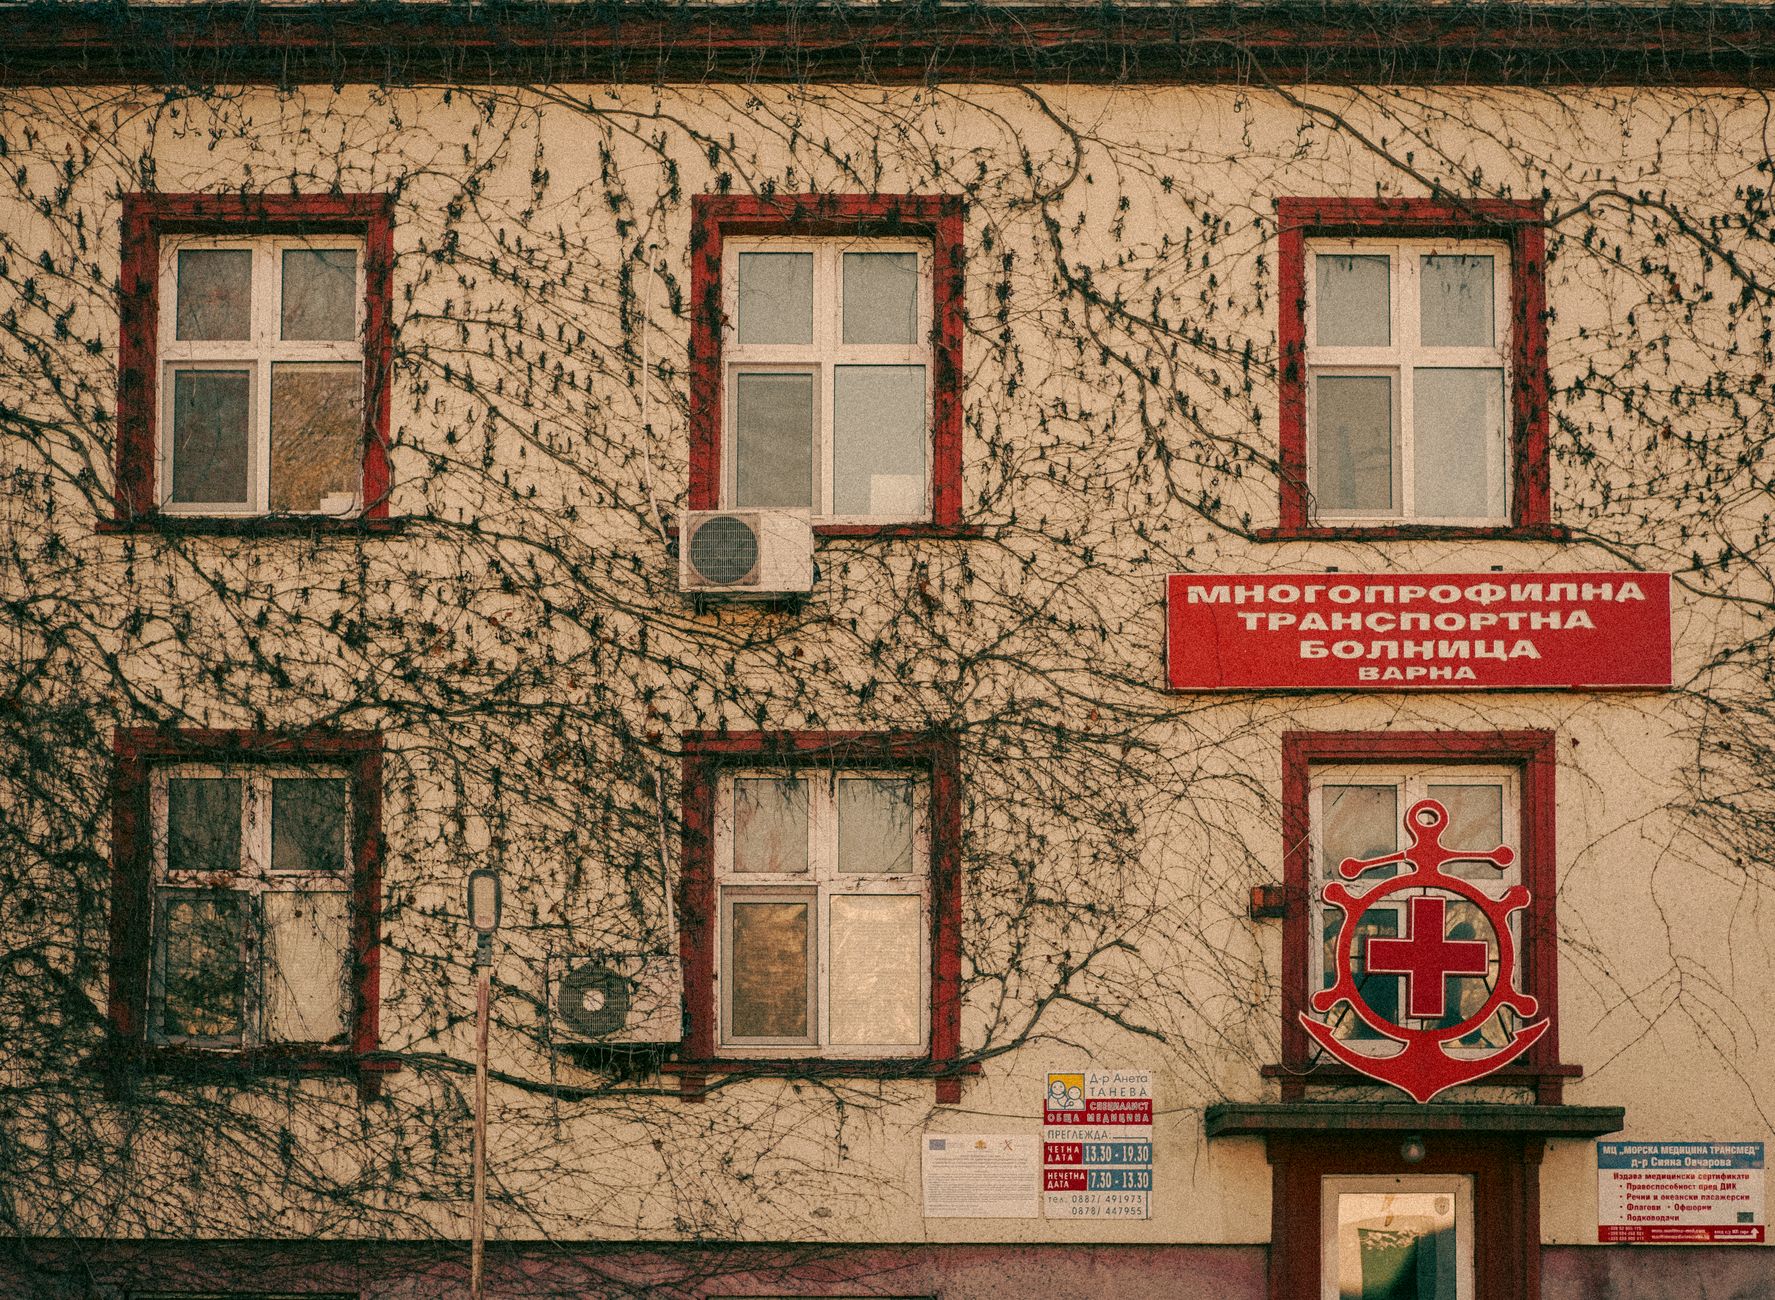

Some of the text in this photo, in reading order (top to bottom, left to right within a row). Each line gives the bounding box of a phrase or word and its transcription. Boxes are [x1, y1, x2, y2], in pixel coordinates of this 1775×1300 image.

[1187, 581, 1646, 606] МНОГОПРОФИЛНА
[1237, 609, 1597, 632] ТРАНСПОРТНА
[1300, 639, 1542, 661] БОЛНИЦА
[1358, 665, 1478, 681] ВАРНА
[1089, 1073, 1148, 1085] Д-р Анета
[1090, 1087, 1148, 1097] ТАНЕВА
[1089, 1101, 1149, 1111] СПЕЦИАЛИСТ
[1047, 1113, 1149, 1123] ОБЩА МЕДИЦИНА
[1047, 1130, 1112, 1141] ПРЕГЛЕЖДА:
[1047, 1145, 1080, 1154] ЧЕТНА
[1085, 1145, 1112, 1162] 13.30
[1122, 1145, 1149, 1162] 19.30
[1603, 1146, 1618, 1156] МЦ
[1660, 1146, 1708, 1156] МЕДИЦИНА
[1047, 1154, 1074, 1162] ДАТА
[1631, 1158, 1649, 1168] д-р
[1684, 1157, 1732, 1168] Овчарова
[1047, 1172, 1085, 1180] НЕЧЕТНА
[1091, 1172, 1112, 1189] 7.30
[1122, 1172, 1149, 1188] 13.30
[1644, 1173, 1696, 1181] медицински
[1047, 1180, 1070, 1189] ДАТА
[1626, 1182, 1697, 1191] Правоспособност
[1720, 1182, 1737, 1191] ДИК
[1626, 1192, 1651, 1201] Речни
[1626, 1203, 1661, 1211] Флагови
